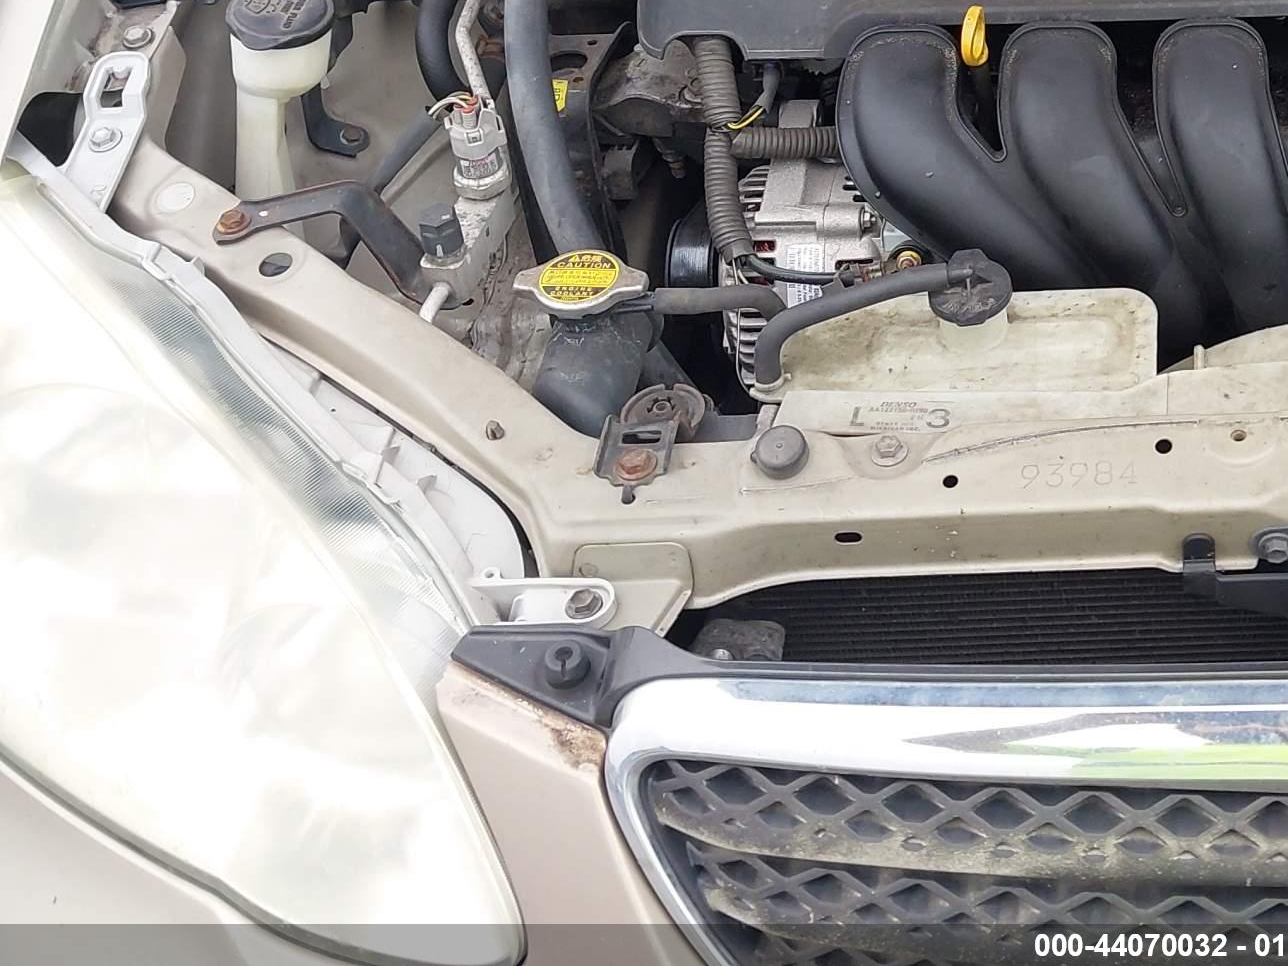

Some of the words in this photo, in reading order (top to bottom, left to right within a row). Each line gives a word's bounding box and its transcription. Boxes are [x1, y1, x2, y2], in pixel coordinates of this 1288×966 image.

[849, 406, 865, 427] L
[925, 408, 951, 429] 3
[1020, 459, 1140, 490] 93984
